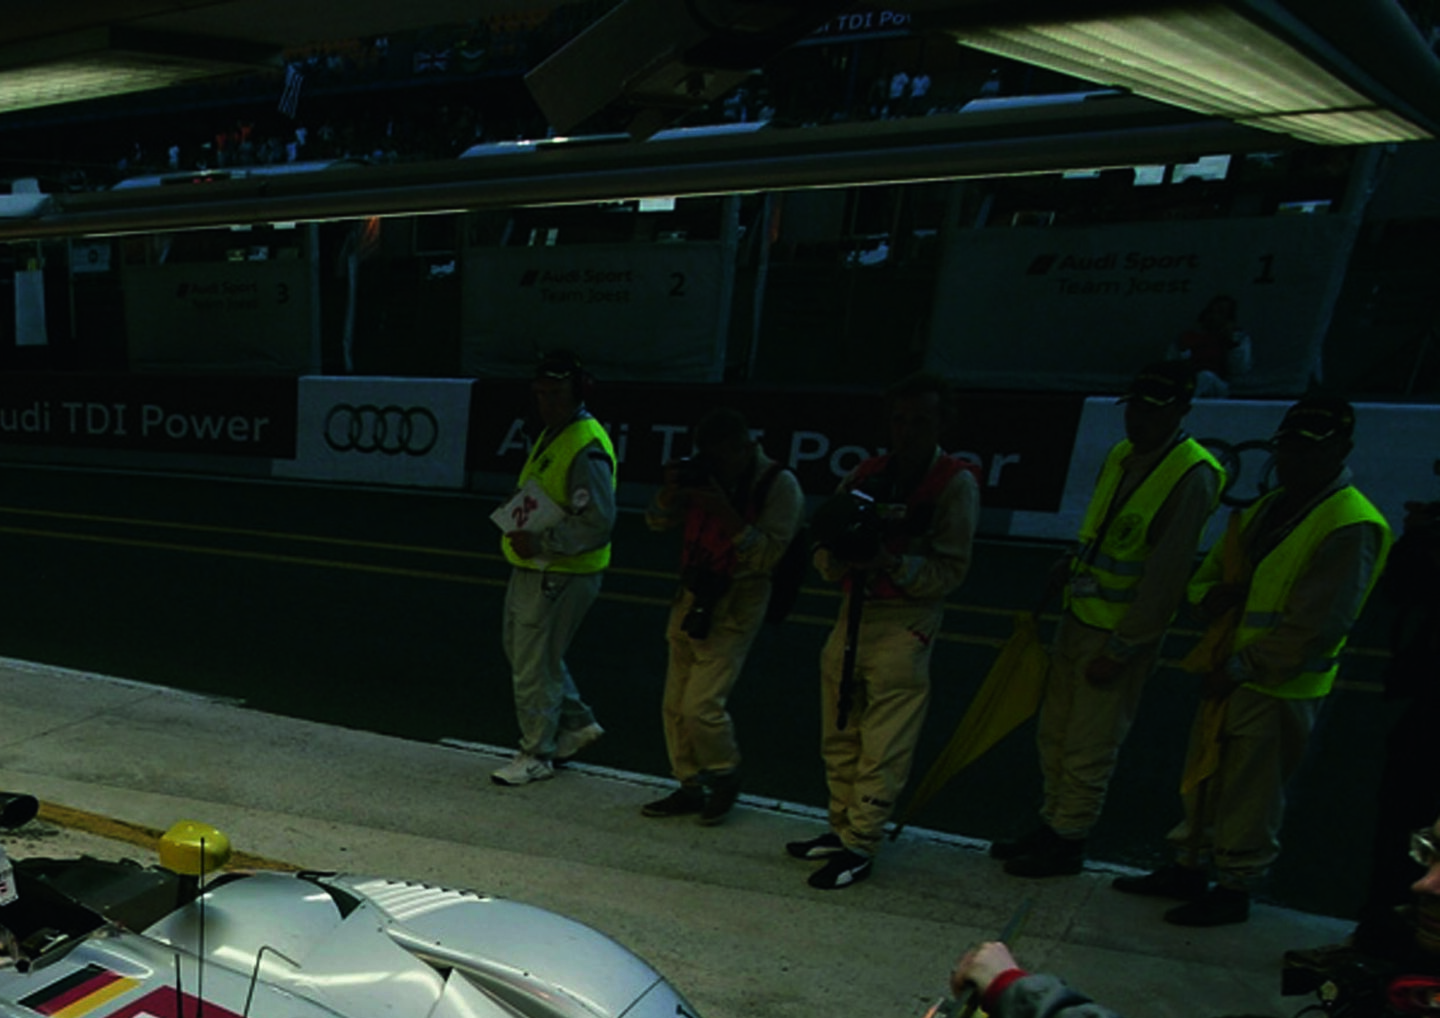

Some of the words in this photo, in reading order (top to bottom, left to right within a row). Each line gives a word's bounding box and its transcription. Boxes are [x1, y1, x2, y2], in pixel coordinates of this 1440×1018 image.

[1058, 253, 1117, 271] Audi
[1123, 252, 1199, 272] Sport
[1253, 254, 1275, 285] 1
[277, 282, 289, 303] 3
[669, 272, 685, 297] 2
[62, 402, 127, 435] TDI
[141, 404, 270, 442] Power
[496, 418, 629, 463] Ai
[788, 430, 1021, 487] Por
